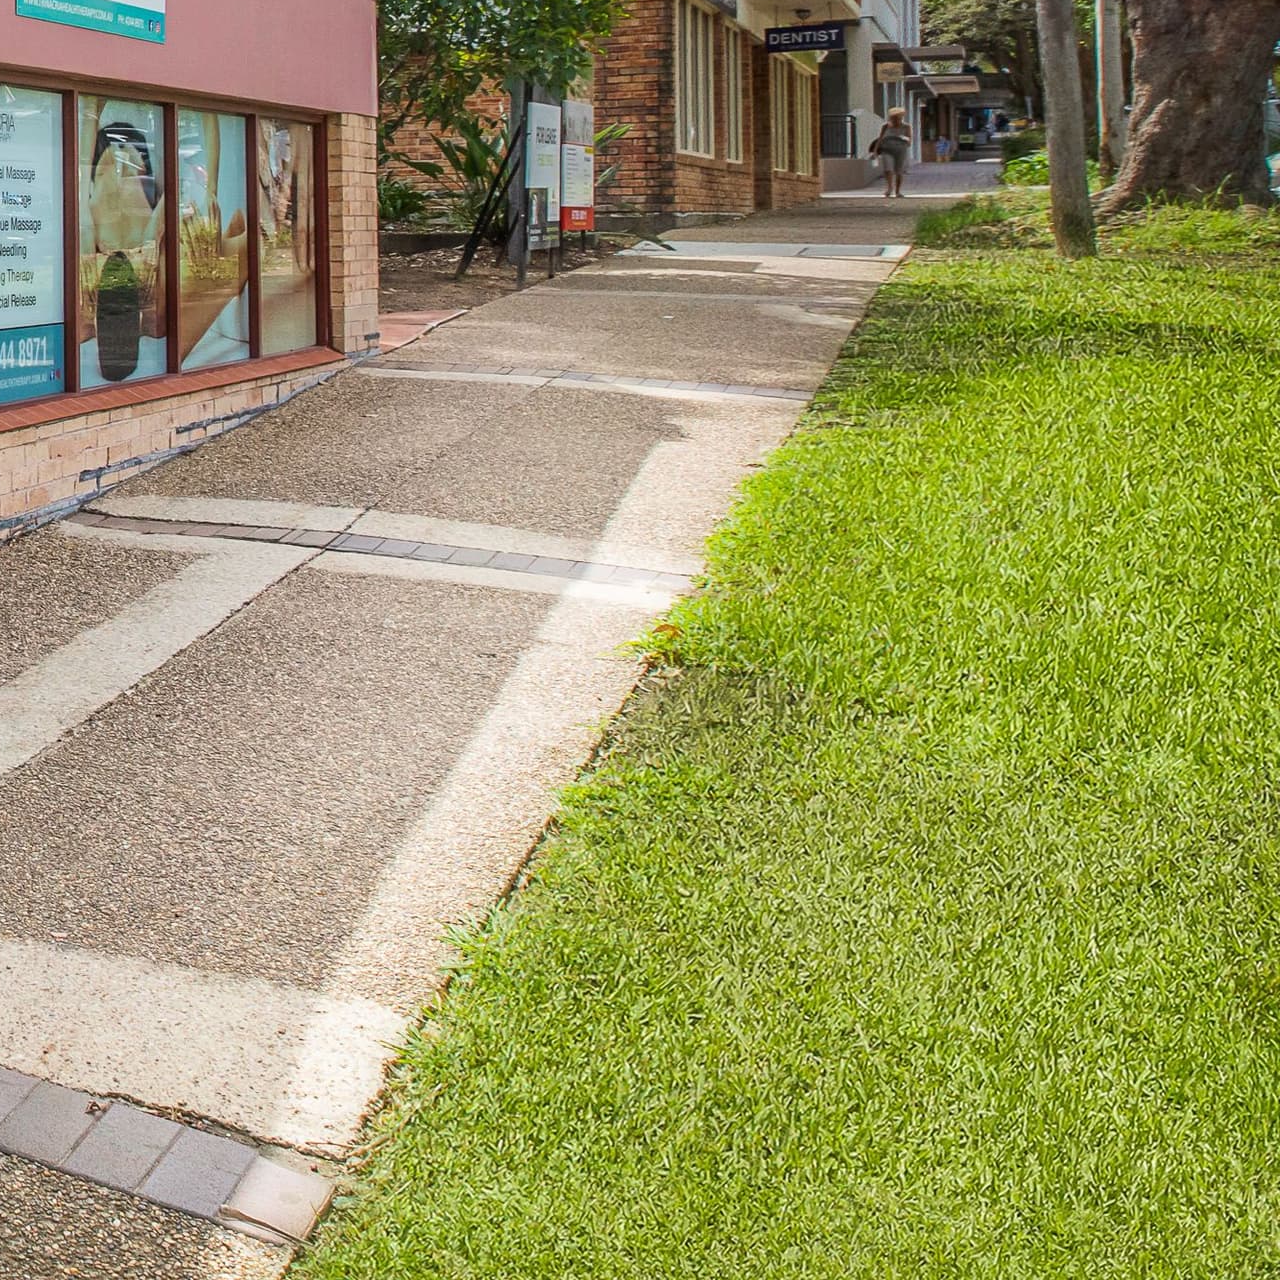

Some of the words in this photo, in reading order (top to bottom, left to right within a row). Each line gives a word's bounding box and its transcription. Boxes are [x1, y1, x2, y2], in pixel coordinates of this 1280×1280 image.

[769, 29, 839, 45] DENTIST
[6, 166, 36, 183] Massage
[2, 191, 32, 208] Massage
[11, 216, 42, 234] Massage
[7, 269, 34, 284] Therapy
[11, 294, 37, 308] Release
[18, 336, 47, 368] 8971
